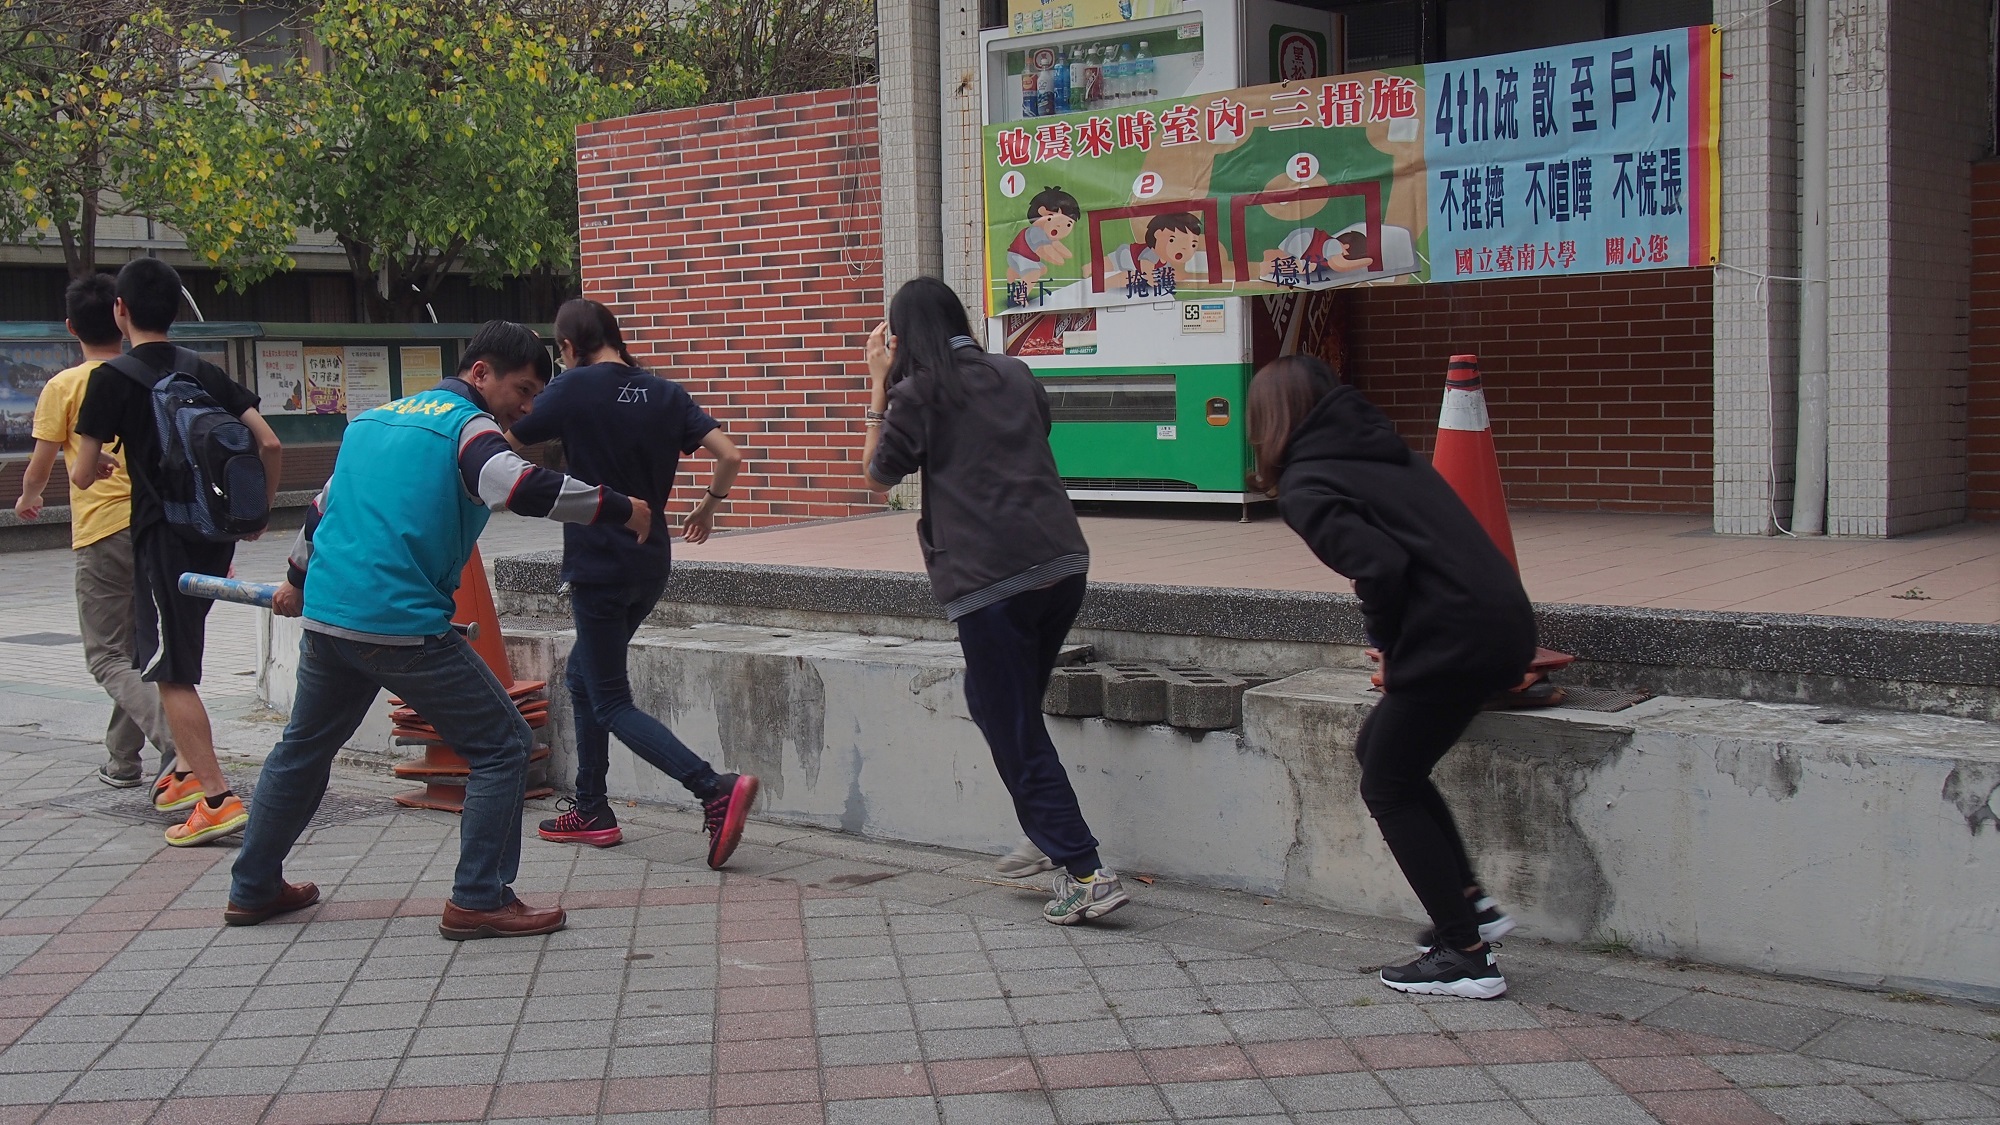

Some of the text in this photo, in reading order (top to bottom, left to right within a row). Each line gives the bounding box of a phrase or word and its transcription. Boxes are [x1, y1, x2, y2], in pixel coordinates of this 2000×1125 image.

[998, 77, 1416, 167] 地震來時室內-三措施
[1296, 157, 1311, 178] 3
[1006, 175, 1015, 194] 1
[1140, 174, 1155, 194] 2
[1439, 148, 1682, 231] 不推擠 不喧嘩 不慌張
[1455, 234, 1669, 275] 國立臺南大學 關心您
[1126, 266, 1177, 299] 掩護
[1271, 255, 1331, 287] 穩住
[1007, 277, 1054, 308] 蹲下
